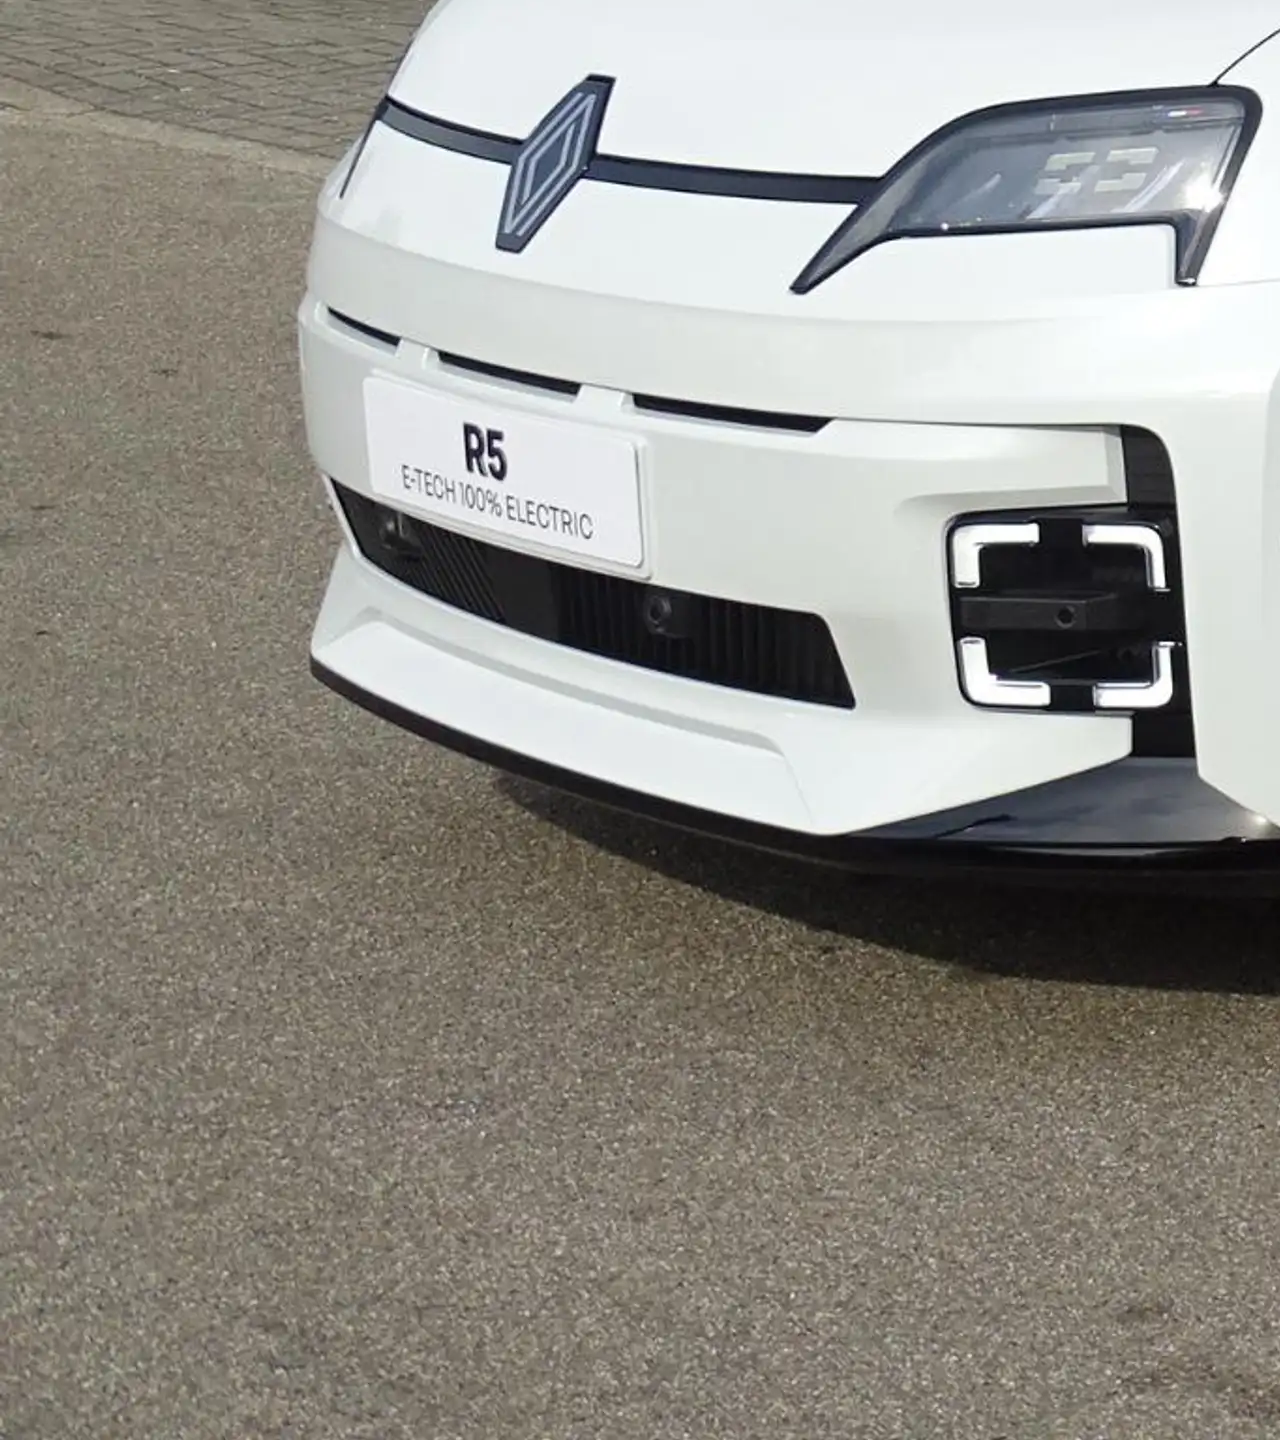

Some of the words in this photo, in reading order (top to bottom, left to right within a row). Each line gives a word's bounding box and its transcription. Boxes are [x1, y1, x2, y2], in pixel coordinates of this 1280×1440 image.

[462, 421, 508, 482] R5
[401, 464, 456, 504] E-TECH
[459, 482, 503, 517] 100%
[506, 495, 595, 540] ELECTRIC
